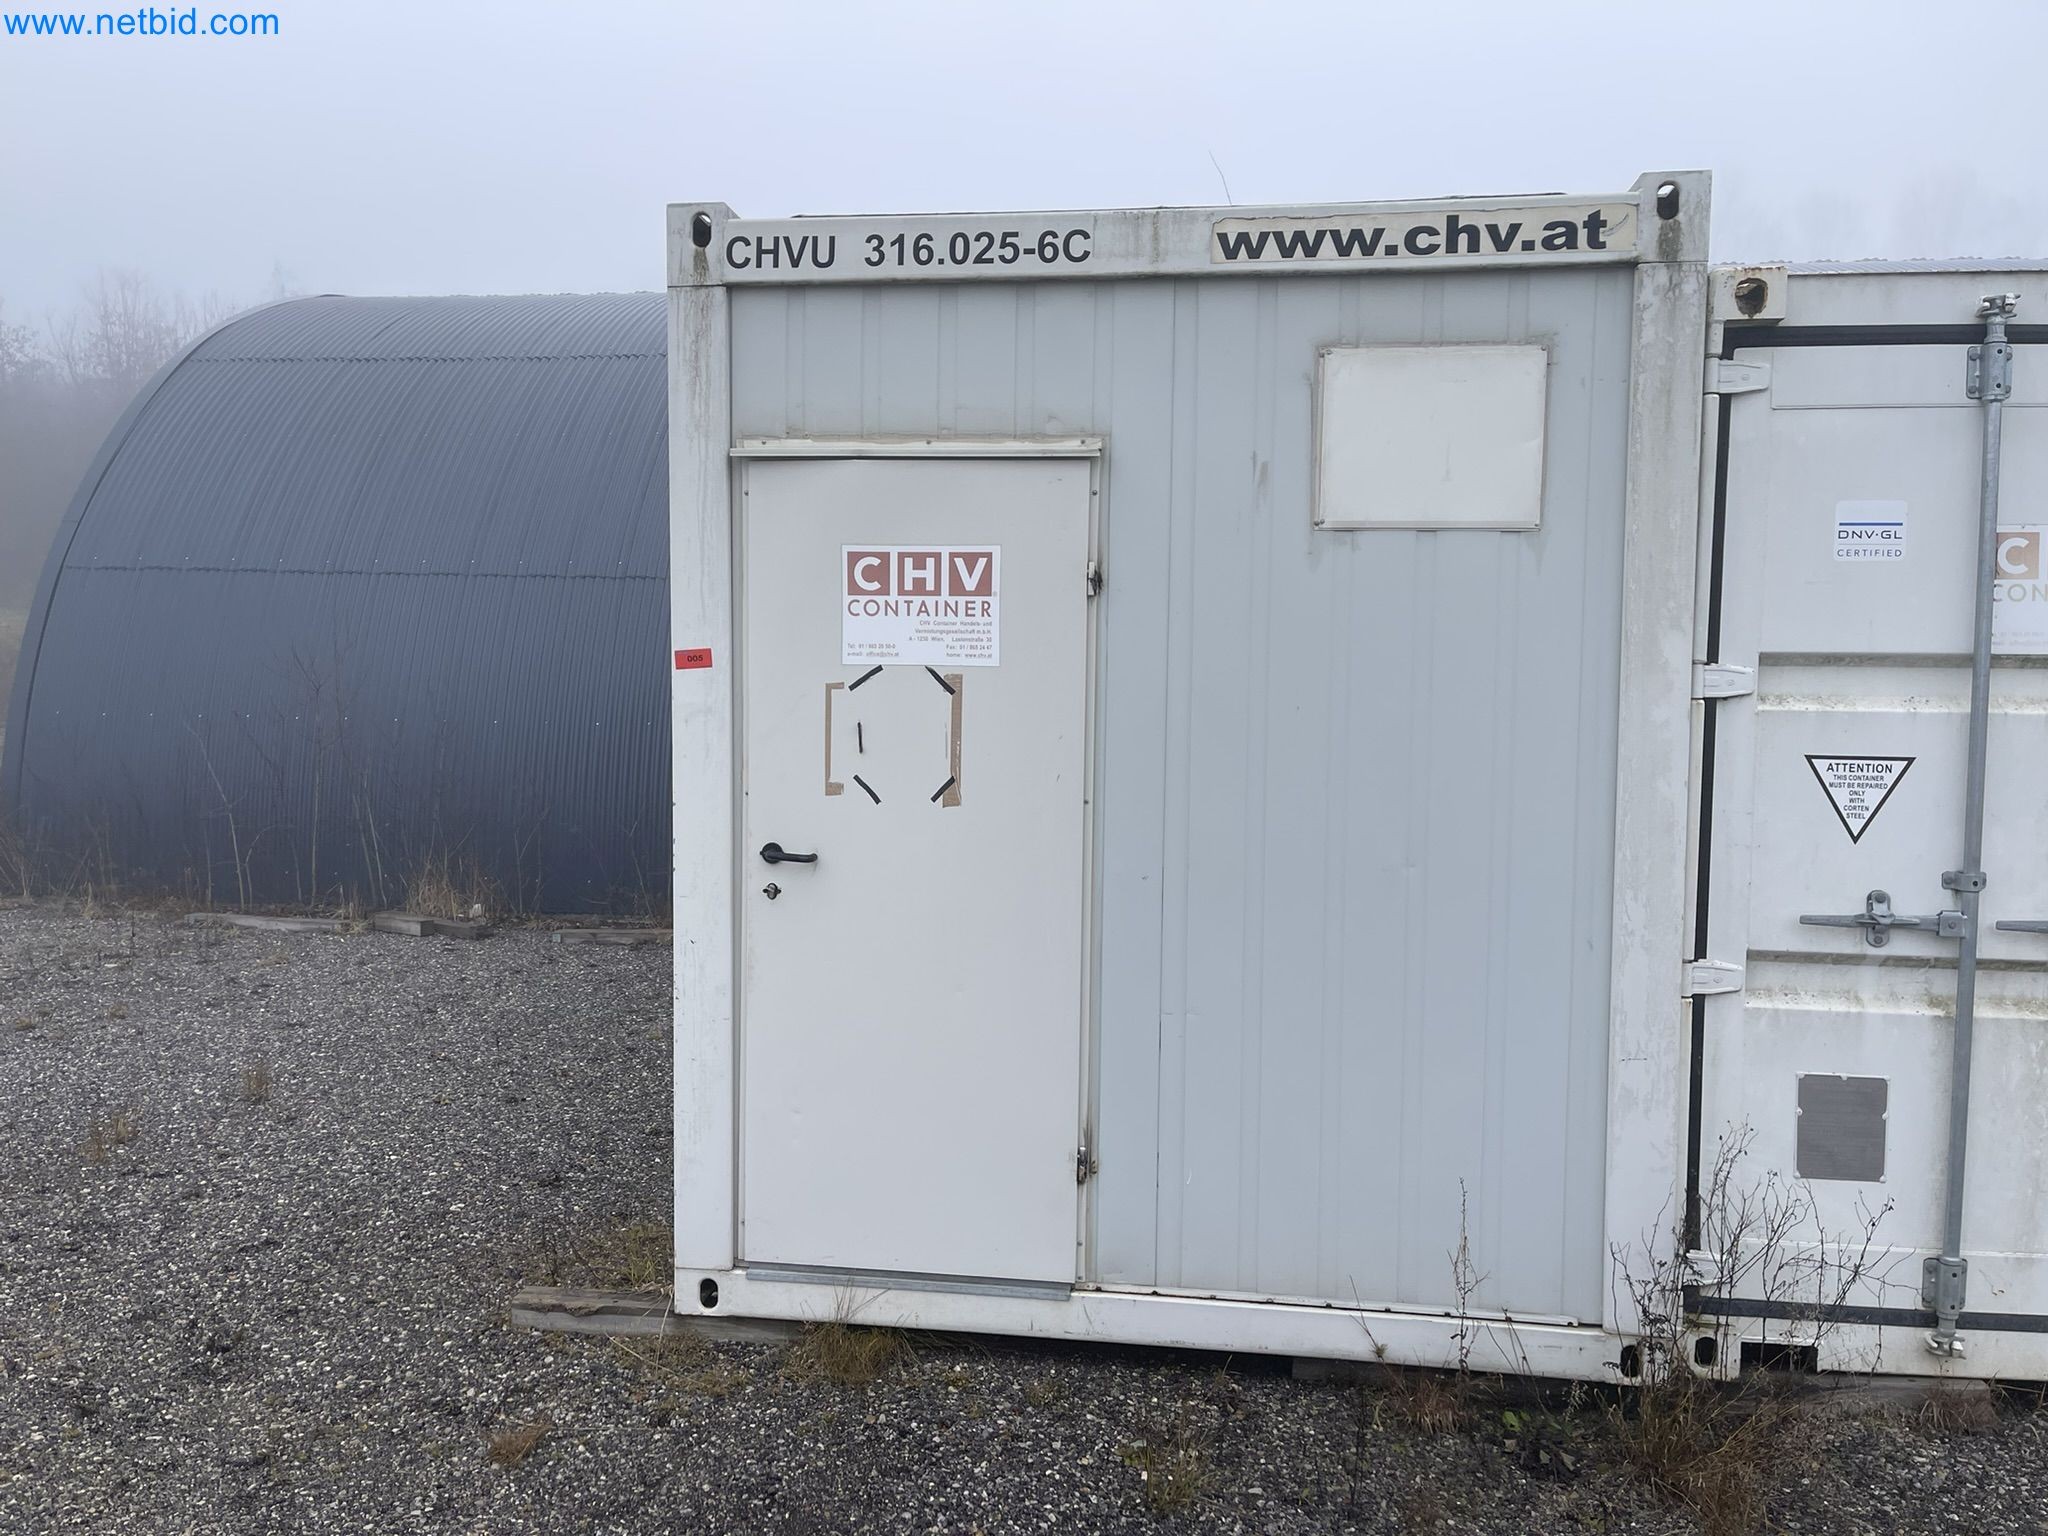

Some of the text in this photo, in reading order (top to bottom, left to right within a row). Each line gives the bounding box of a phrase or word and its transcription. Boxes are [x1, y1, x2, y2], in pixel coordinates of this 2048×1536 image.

[1216, 208, 1608, 260] www.chv.at
[726, 229, 1092, 269] CHVU 316.025-6C
[1837, 549, 1902, 558] CERTIFIED
[852, 555, 990, 593] CHV
[848, 599, 992, 618] CONTAINER
[1826, 763, 1893, 773] ATTENTION
[1846, 812, 1866, 820] STEEL
